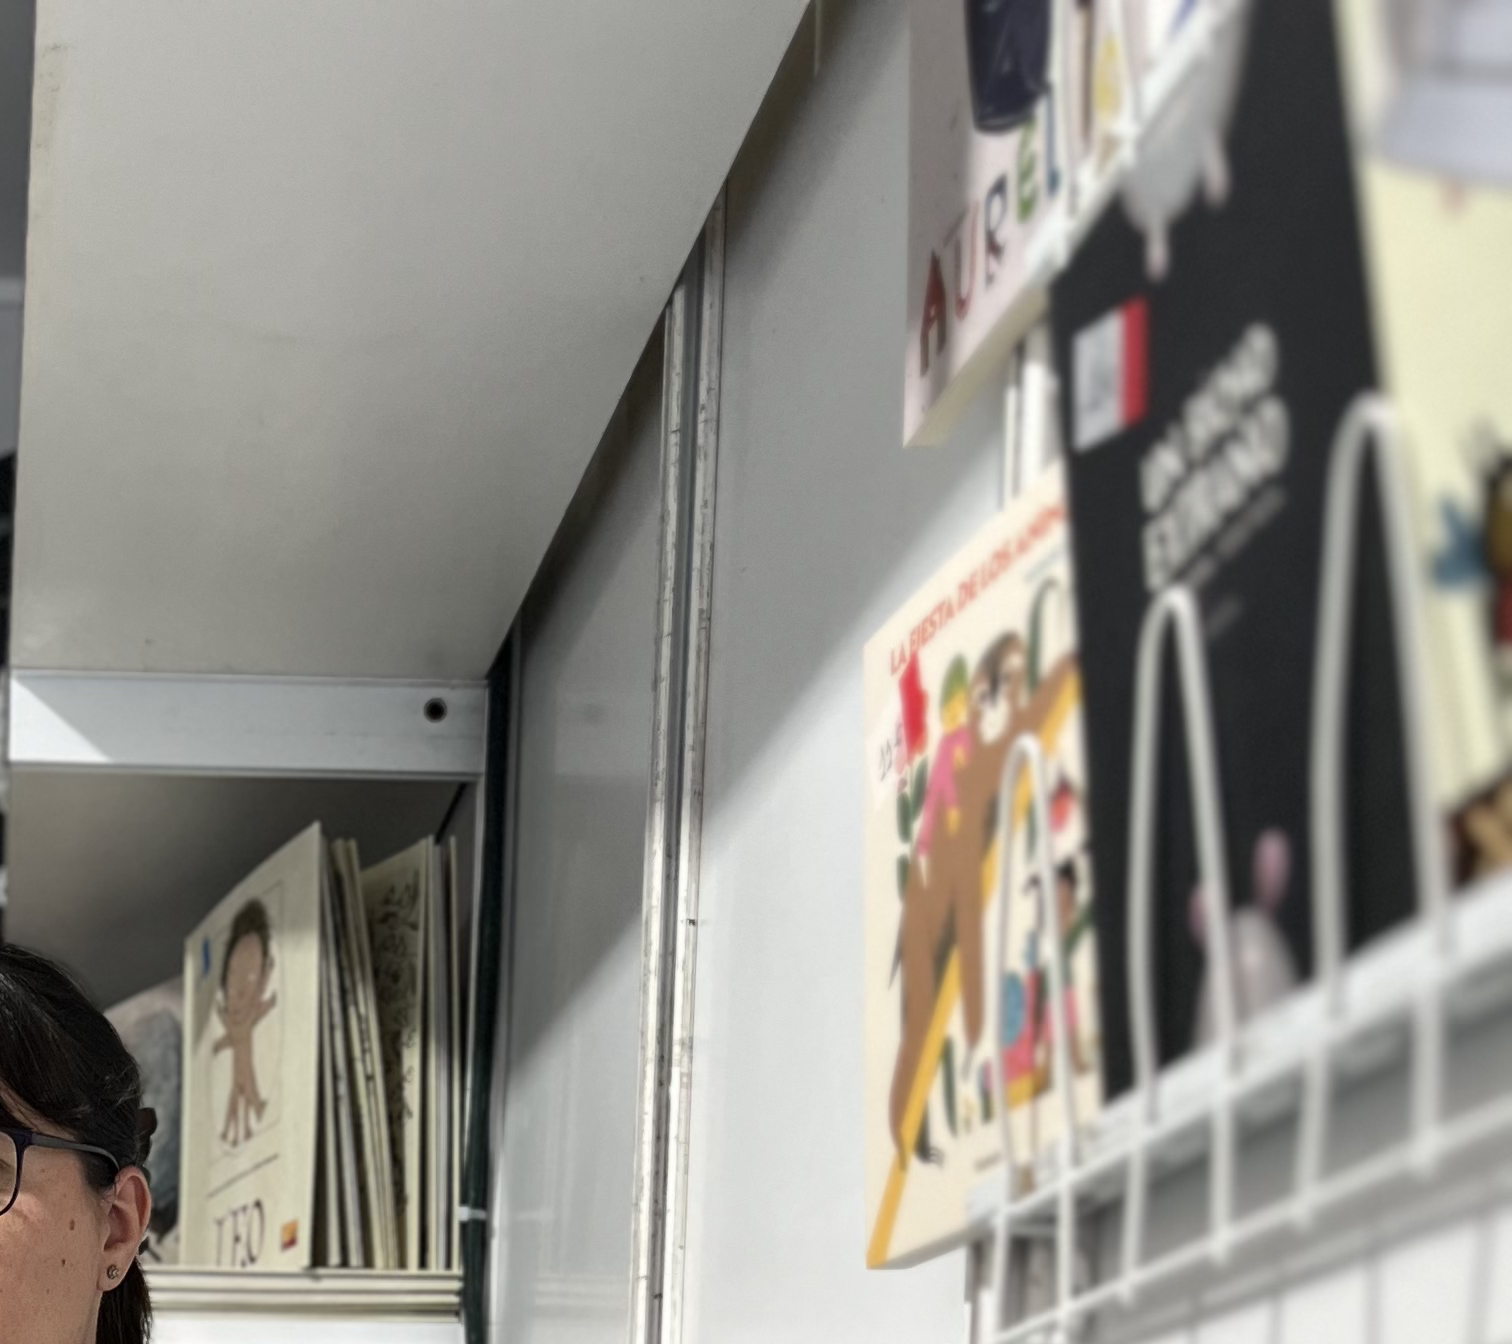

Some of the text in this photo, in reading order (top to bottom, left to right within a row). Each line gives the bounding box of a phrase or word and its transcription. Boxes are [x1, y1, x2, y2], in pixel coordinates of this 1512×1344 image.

[891, 641, 907, 677] LA
[909, 596, 955, 650] FIESTA
[956, 571, 979, 612] DE
[981, 542, 1014, 590] LOS
